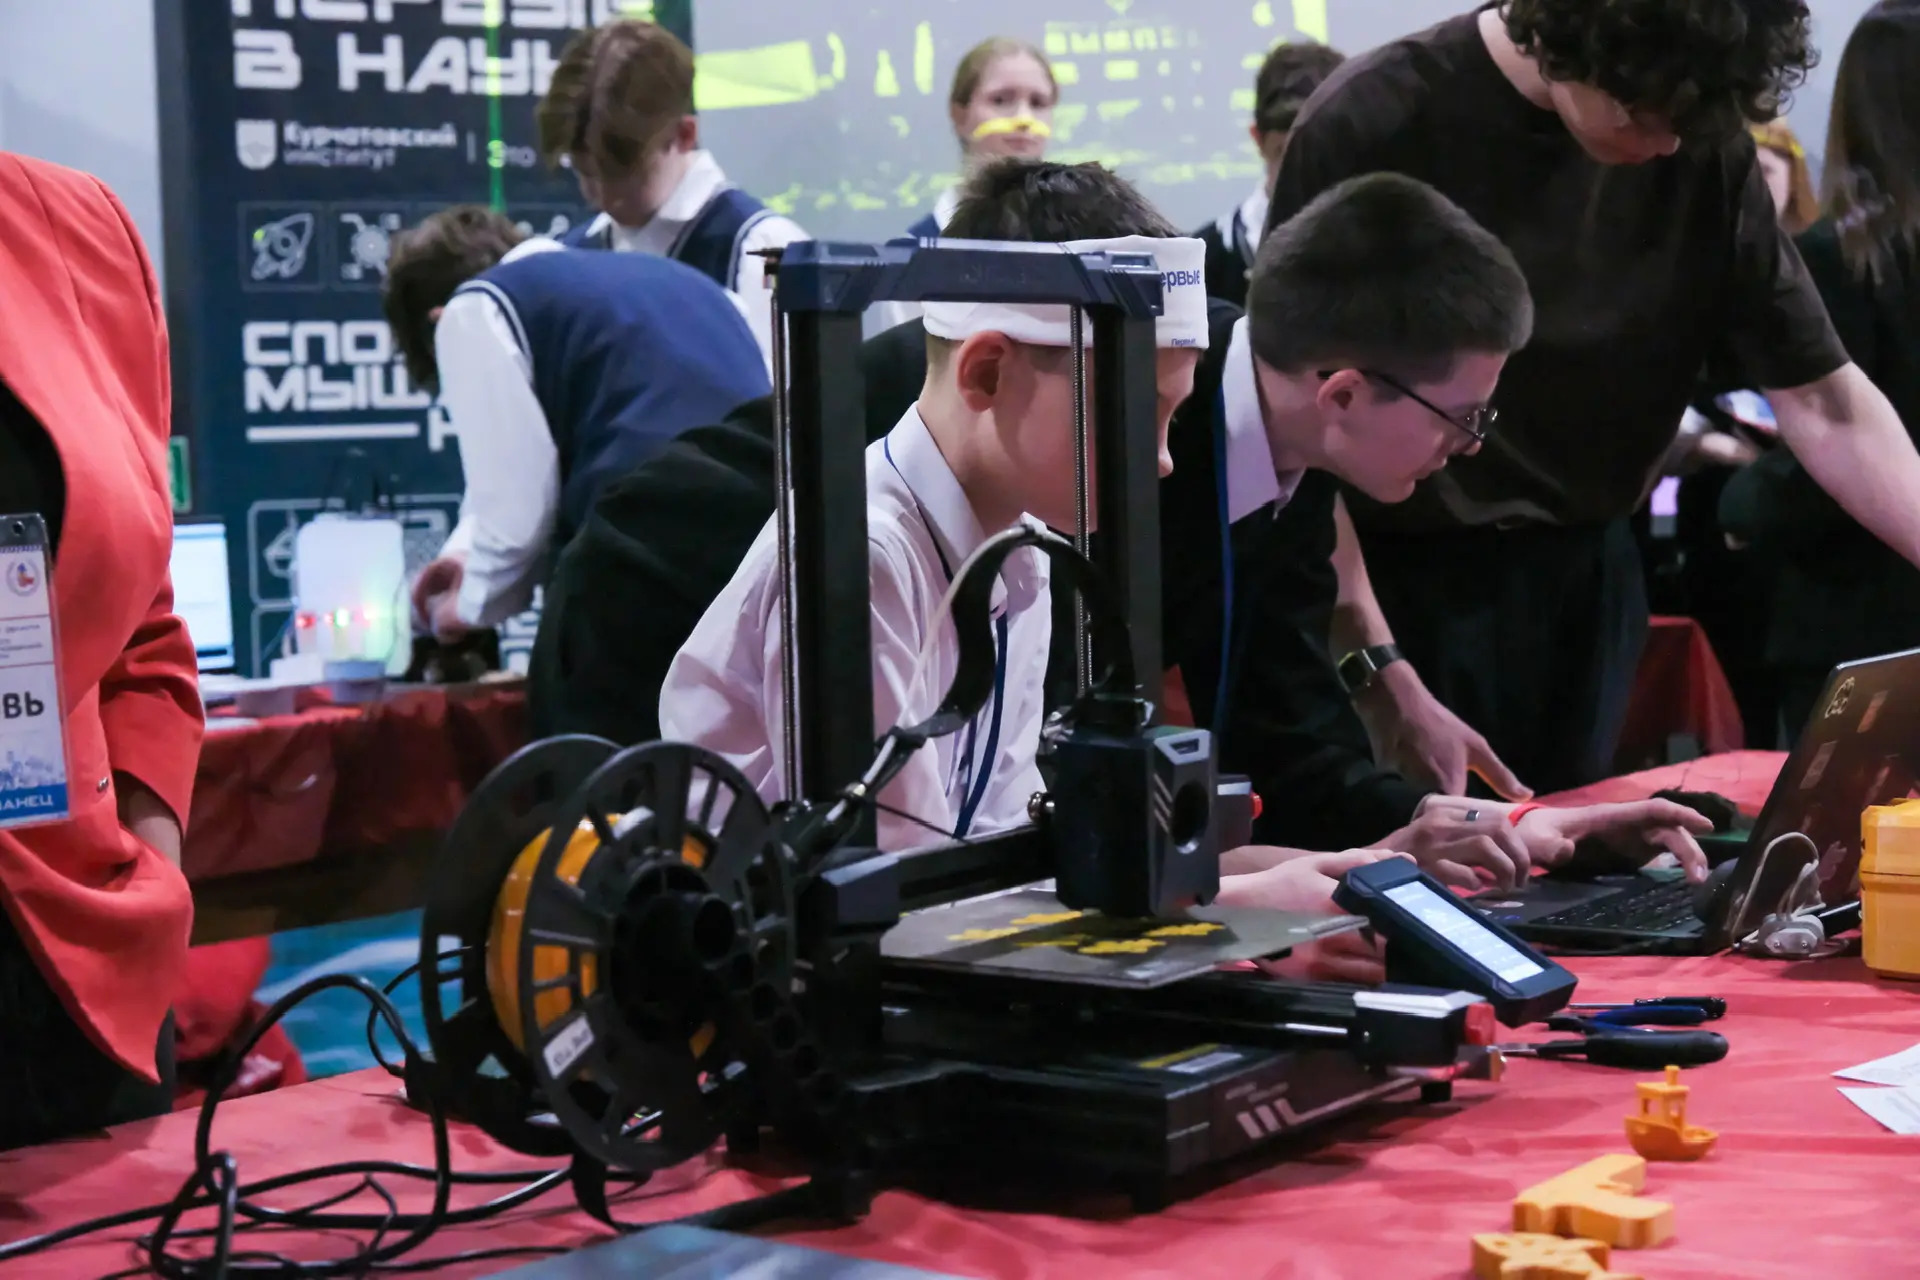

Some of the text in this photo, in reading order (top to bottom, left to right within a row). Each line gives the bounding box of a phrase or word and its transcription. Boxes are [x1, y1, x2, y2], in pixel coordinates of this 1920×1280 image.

[233, 29, 302, 89] В
[243, 321, 406, 366] СПО
[0, 794, 53, 811] АНЕЦ
